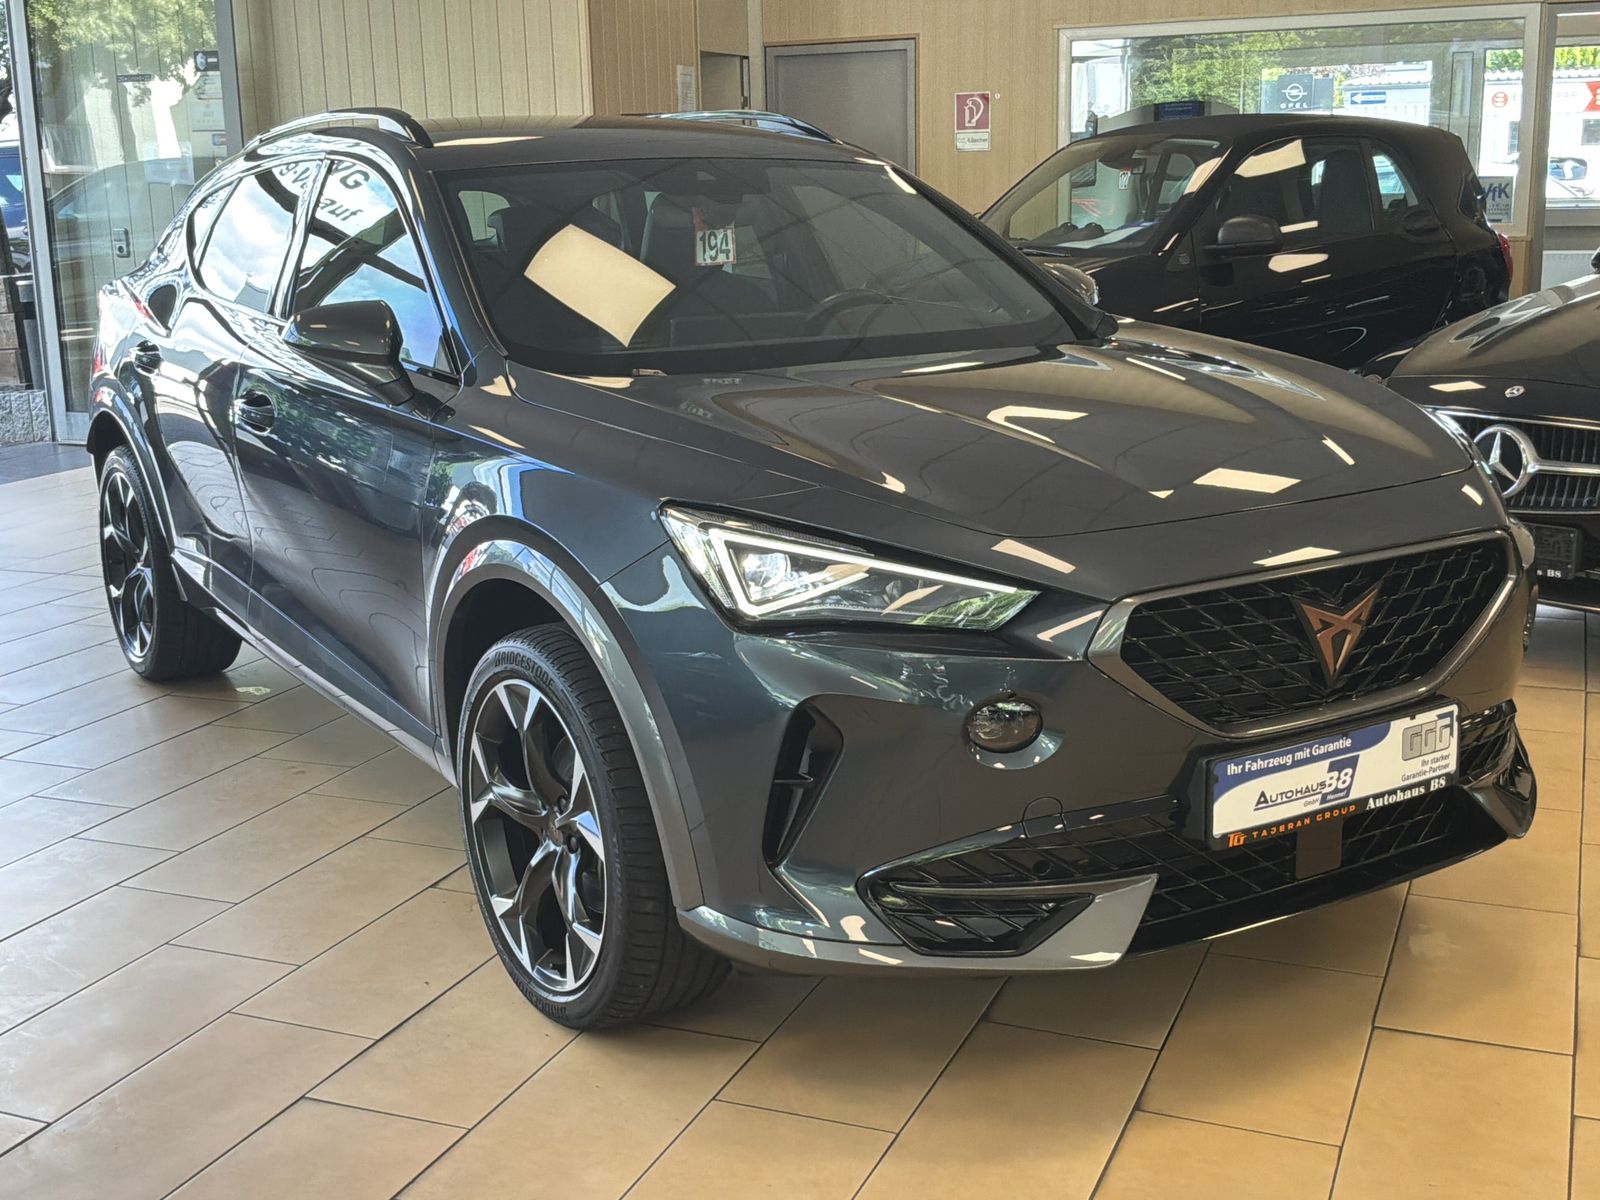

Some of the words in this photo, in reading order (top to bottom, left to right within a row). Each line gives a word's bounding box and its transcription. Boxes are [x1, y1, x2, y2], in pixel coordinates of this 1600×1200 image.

[699, 230, 731, 262] 194
[1227, 763, 1243, 777] Ihr
[1244, 752, 1293, 774] Fahrzeug
[1294, 748, 1311, 761] mit
[1311, 736, 1353, 756] Garantie
[1401, 762, 1451, 782] Garantie-Partner
[1421, 757, 1431, 767] Ihr
[1430, 753, 1451, 766] starker
[1303, 797, 1320, 807] GmbH
[1365, 785, 1426, 811] Autohaus
[1429, 776, 1447, 792] B8
[1252, 817, 1311, 840] TAJERAN
[1316, 804, 1357, 822] GROUP
